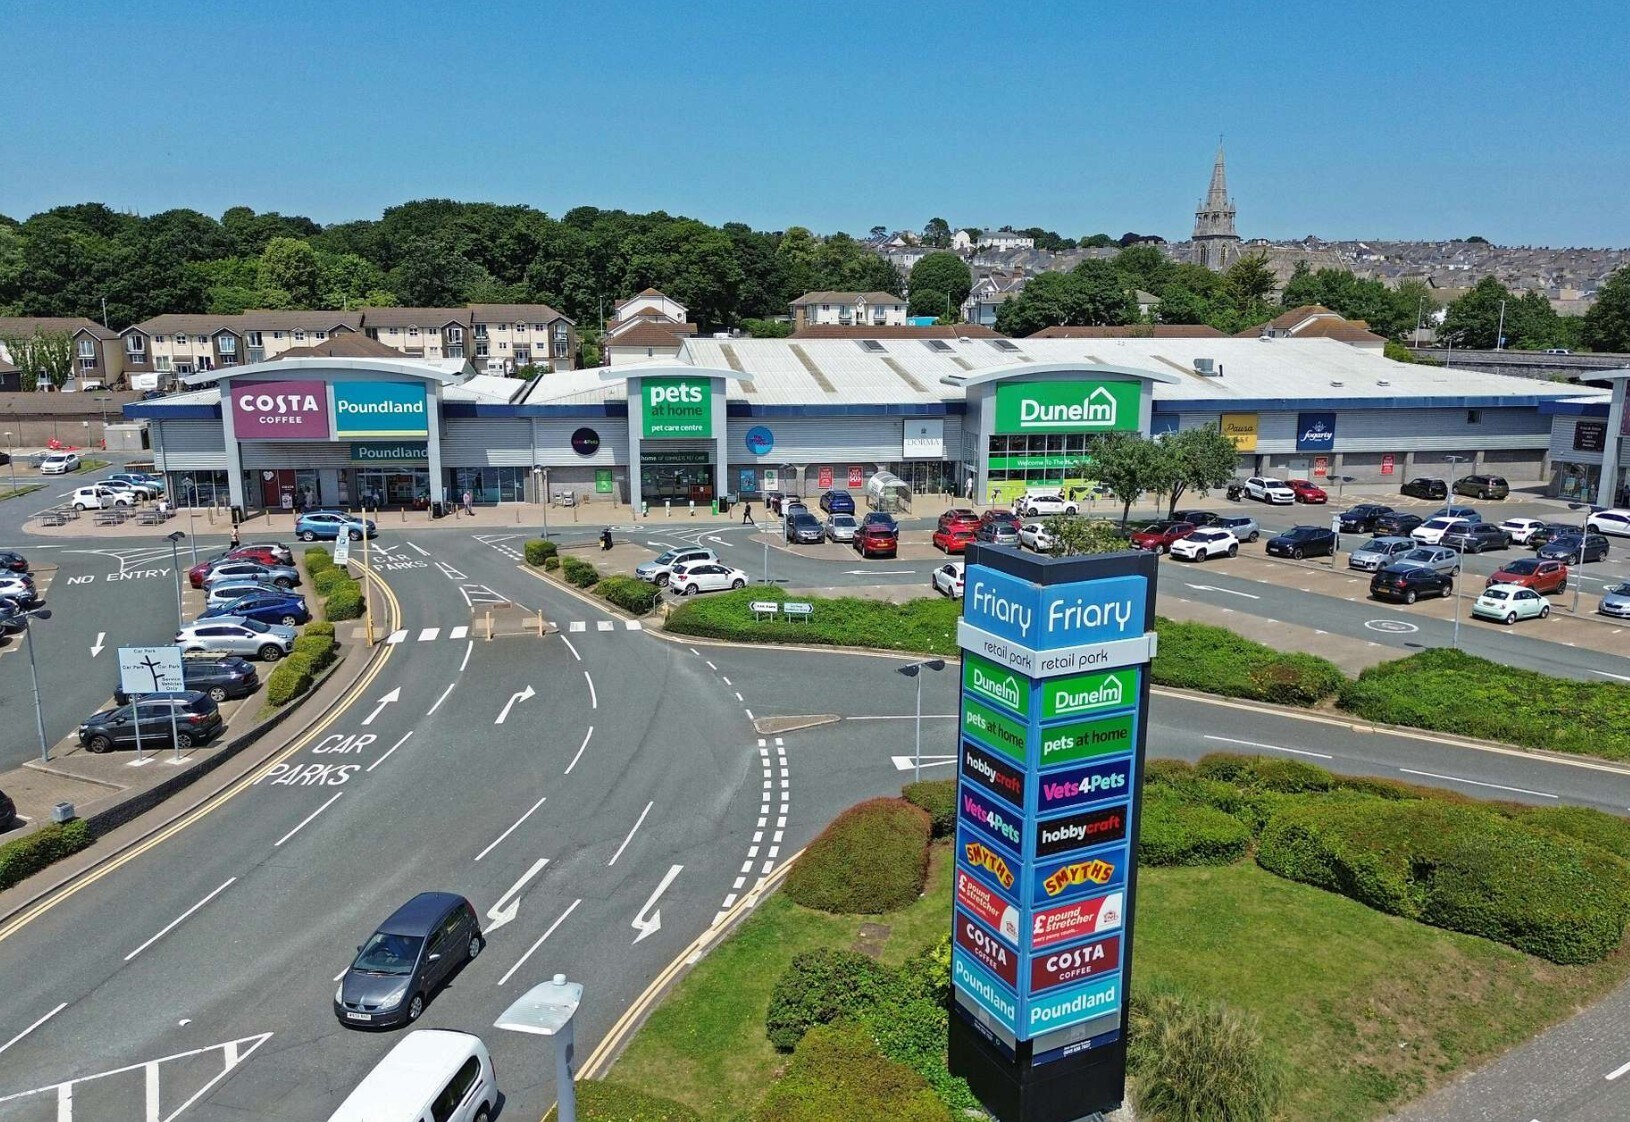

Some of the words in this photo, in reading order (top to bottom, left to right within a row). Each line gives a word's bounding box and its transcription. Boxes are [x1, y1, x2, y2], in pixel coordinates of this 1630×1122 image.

[239, 394, 319, 414] COSTA
[338, 400, 424, 413] Poundland
[650, 383, 703, 407] pets
[259, 416, 302, 424] COFFEE
[651, 405, 665, 416] at
[667, 404, 703, 416] home
[1020, 397, 1112, 423] Dunelm
[651, 424, 663, 433] pet
[1225, 423, 1254, 432] Pausa
[1301, 430, 1333, 441] fogarty
[359, 447, 428, 458] Poundland
[907, 437, 940, 446] DORMA
[372, 553, 411, 563] CAR
[372, 560, 428, 572] PARKS
[67, 575, 95, 585] NO
[106, 568, 170, 582] ENTRY
[984, 641, 1008, 663] retail
[1010, 651, 1031, 670] park
[1041, 653, 1075, 671] retail
[1078, 649, 1108, 670] park
[974, 669, 1018, 705] Dunelm
[1056, 682, 1120, 710] Dunelm
[966, 711, 986, 730] pets
[987, 721, 997, 734] at
[998, 725, 1024, 749] home
[1044, 736, 1074, 755] pets
[1076, 734, 1089, 746] at
[1092, 727, 1128, 744] home
[312, 734, 377, 754] CAR
[253, 763, 361, 786] PARKS
[966, 752, 1020, 794] hobbycraft
[1043, 773, 1125, 801] Vets4Pets
[964, 794, 1020, 844] Vets4Pets
[1042, 815, 1120, 844] hobbycraft
[966, 844, 1014, 888] SMYTHS
[1044, 861, 1114, 895] SMYTHS
[958, 874, 967, 893] £
[967, 882, 990, 902] pound
[967, 890, 1000, 917] stretcher
[1033, 914, 1047, 935] £
[1048, 906, 1081, 925] pound
[1046, 913, 1095, 932] stretcher
[966, 923, 1007, 966] COSTA
[974, 947, 998, 970] COFFEE
[1046, 944, 1105, 973] COSTA
[1059, 966, 1092, 981] COFFEE
[956, 960, 1015, 1022] Poundland
[1031, 986, 1115, 1025] Poundland
